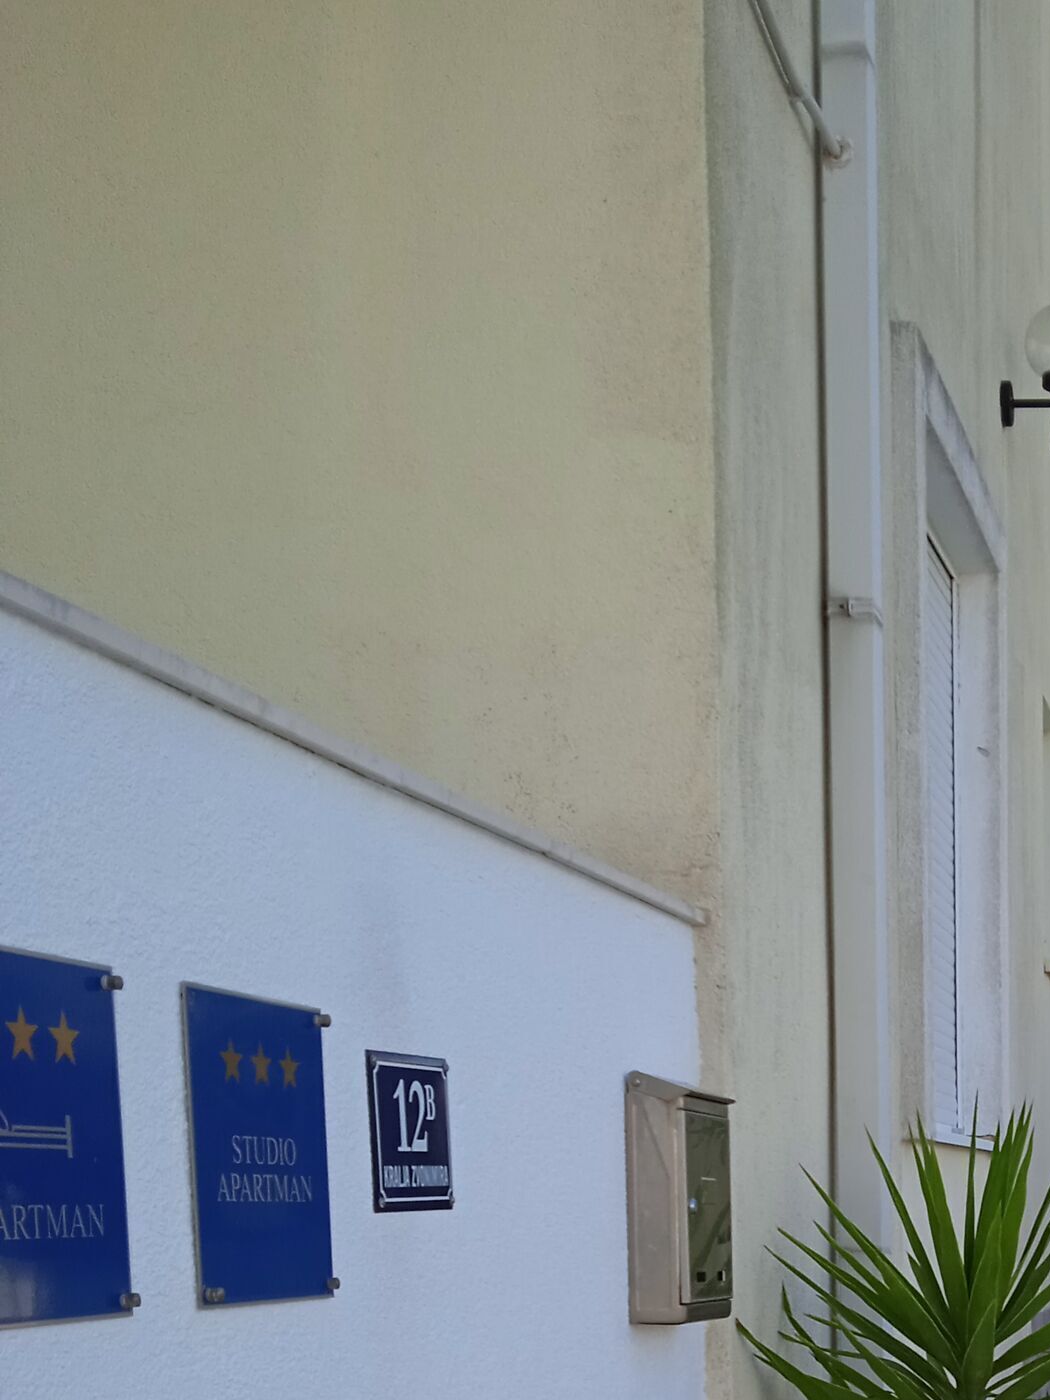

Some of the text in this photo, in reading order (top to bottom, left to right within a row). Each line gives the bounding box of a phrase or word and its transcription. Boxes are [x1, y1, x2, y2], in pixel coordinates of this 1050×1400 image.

[393, 1078, 436, 1152] 12B
[231, 1134, 297, 1166] STUDIO
[217, 1172, 313, 1203] APARTMAN
